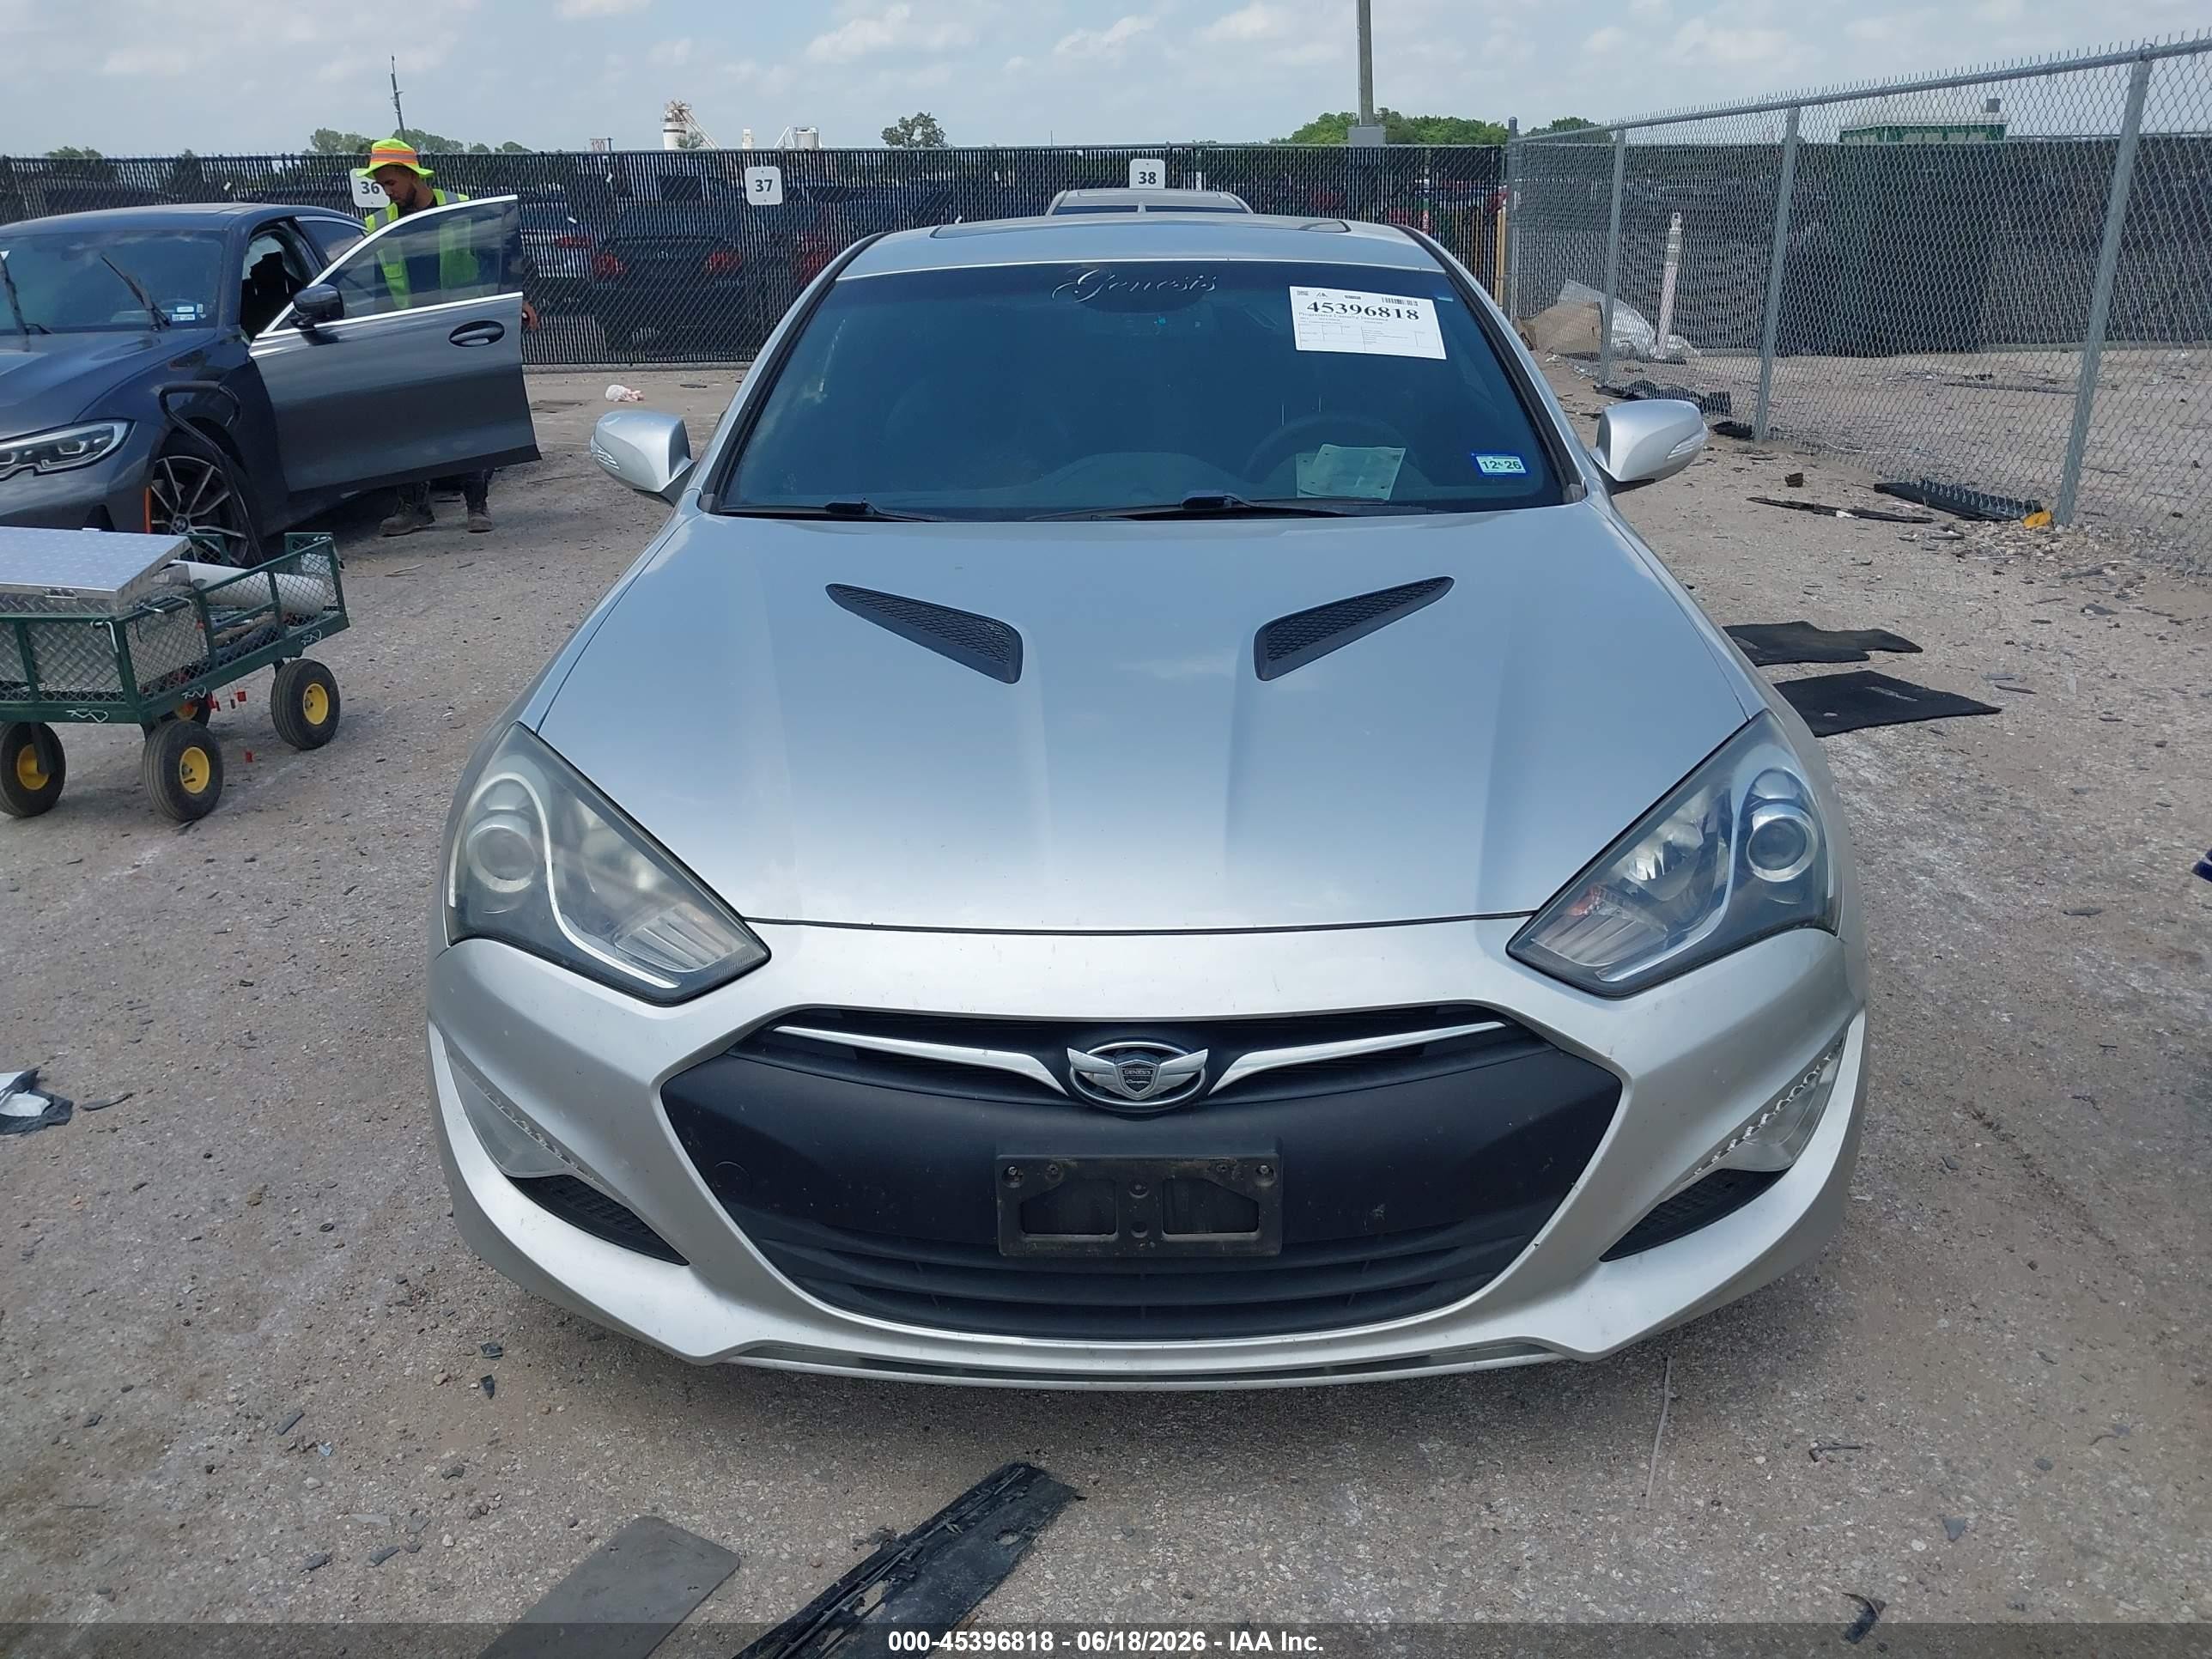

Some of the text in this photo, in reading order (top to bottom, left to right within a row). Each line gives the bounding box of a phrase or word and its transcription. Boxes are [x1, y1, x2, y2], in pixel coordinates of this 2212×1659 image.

[1139, 171, 1157, 185] 38
[361, 181, 380, 195] 36
[755, 179, 773, 192] 37
[1051, 267, 1217, 303] Genesis
[1306, 301, 1419, 320] 45396818
